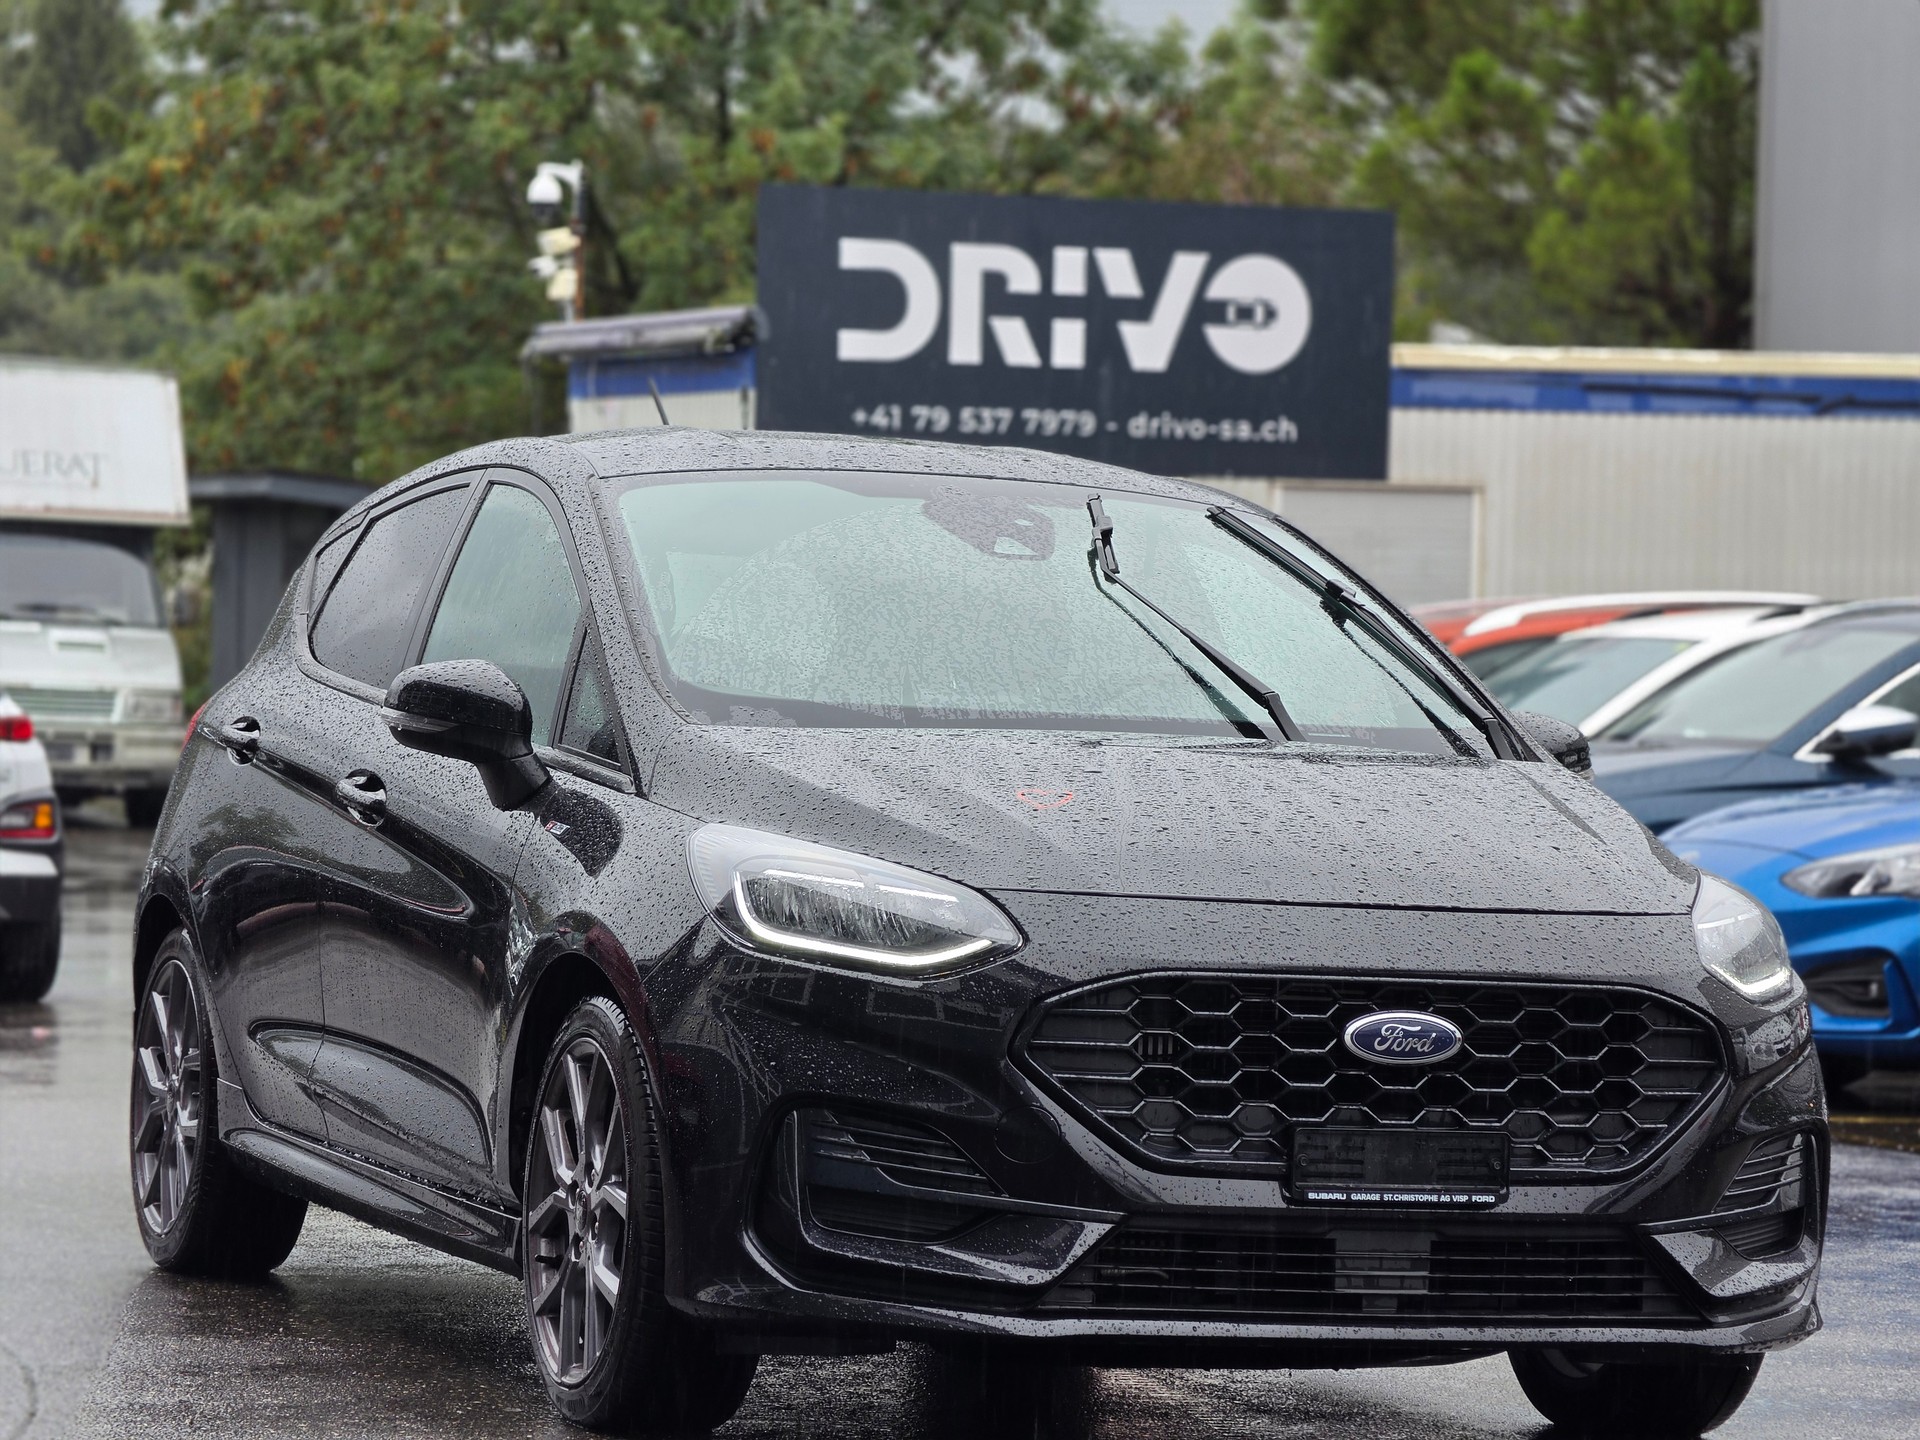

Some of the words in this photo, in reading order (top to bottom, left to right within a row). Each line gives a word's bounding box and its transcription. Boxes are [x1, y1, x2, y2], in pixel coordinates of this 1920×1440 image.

[836, 236, 1313, 375] DRIVO
[852, 404, 902, 430] +41
[910, 404, 951, 433] 79
[959, 406, 1014, 434] 537
[1021, 408, 1097, 437] 7979
[1127, 411, 1298, 442] drivo-sa.ch
[1374, 1023, 1437, 1053] Ford
[1307, 1192, 1347, 1200] SUBARU
[1350, 1193, 1381, 1201] GARAGE
[1383, 1193, 1438, 1202] ST.CHRISTOPHE
[1440, 1194, 1451, 1202] AG
[1452, 1194, 1469, 1203] VISP
[1472, 1195, 1496, 1203] FORD
